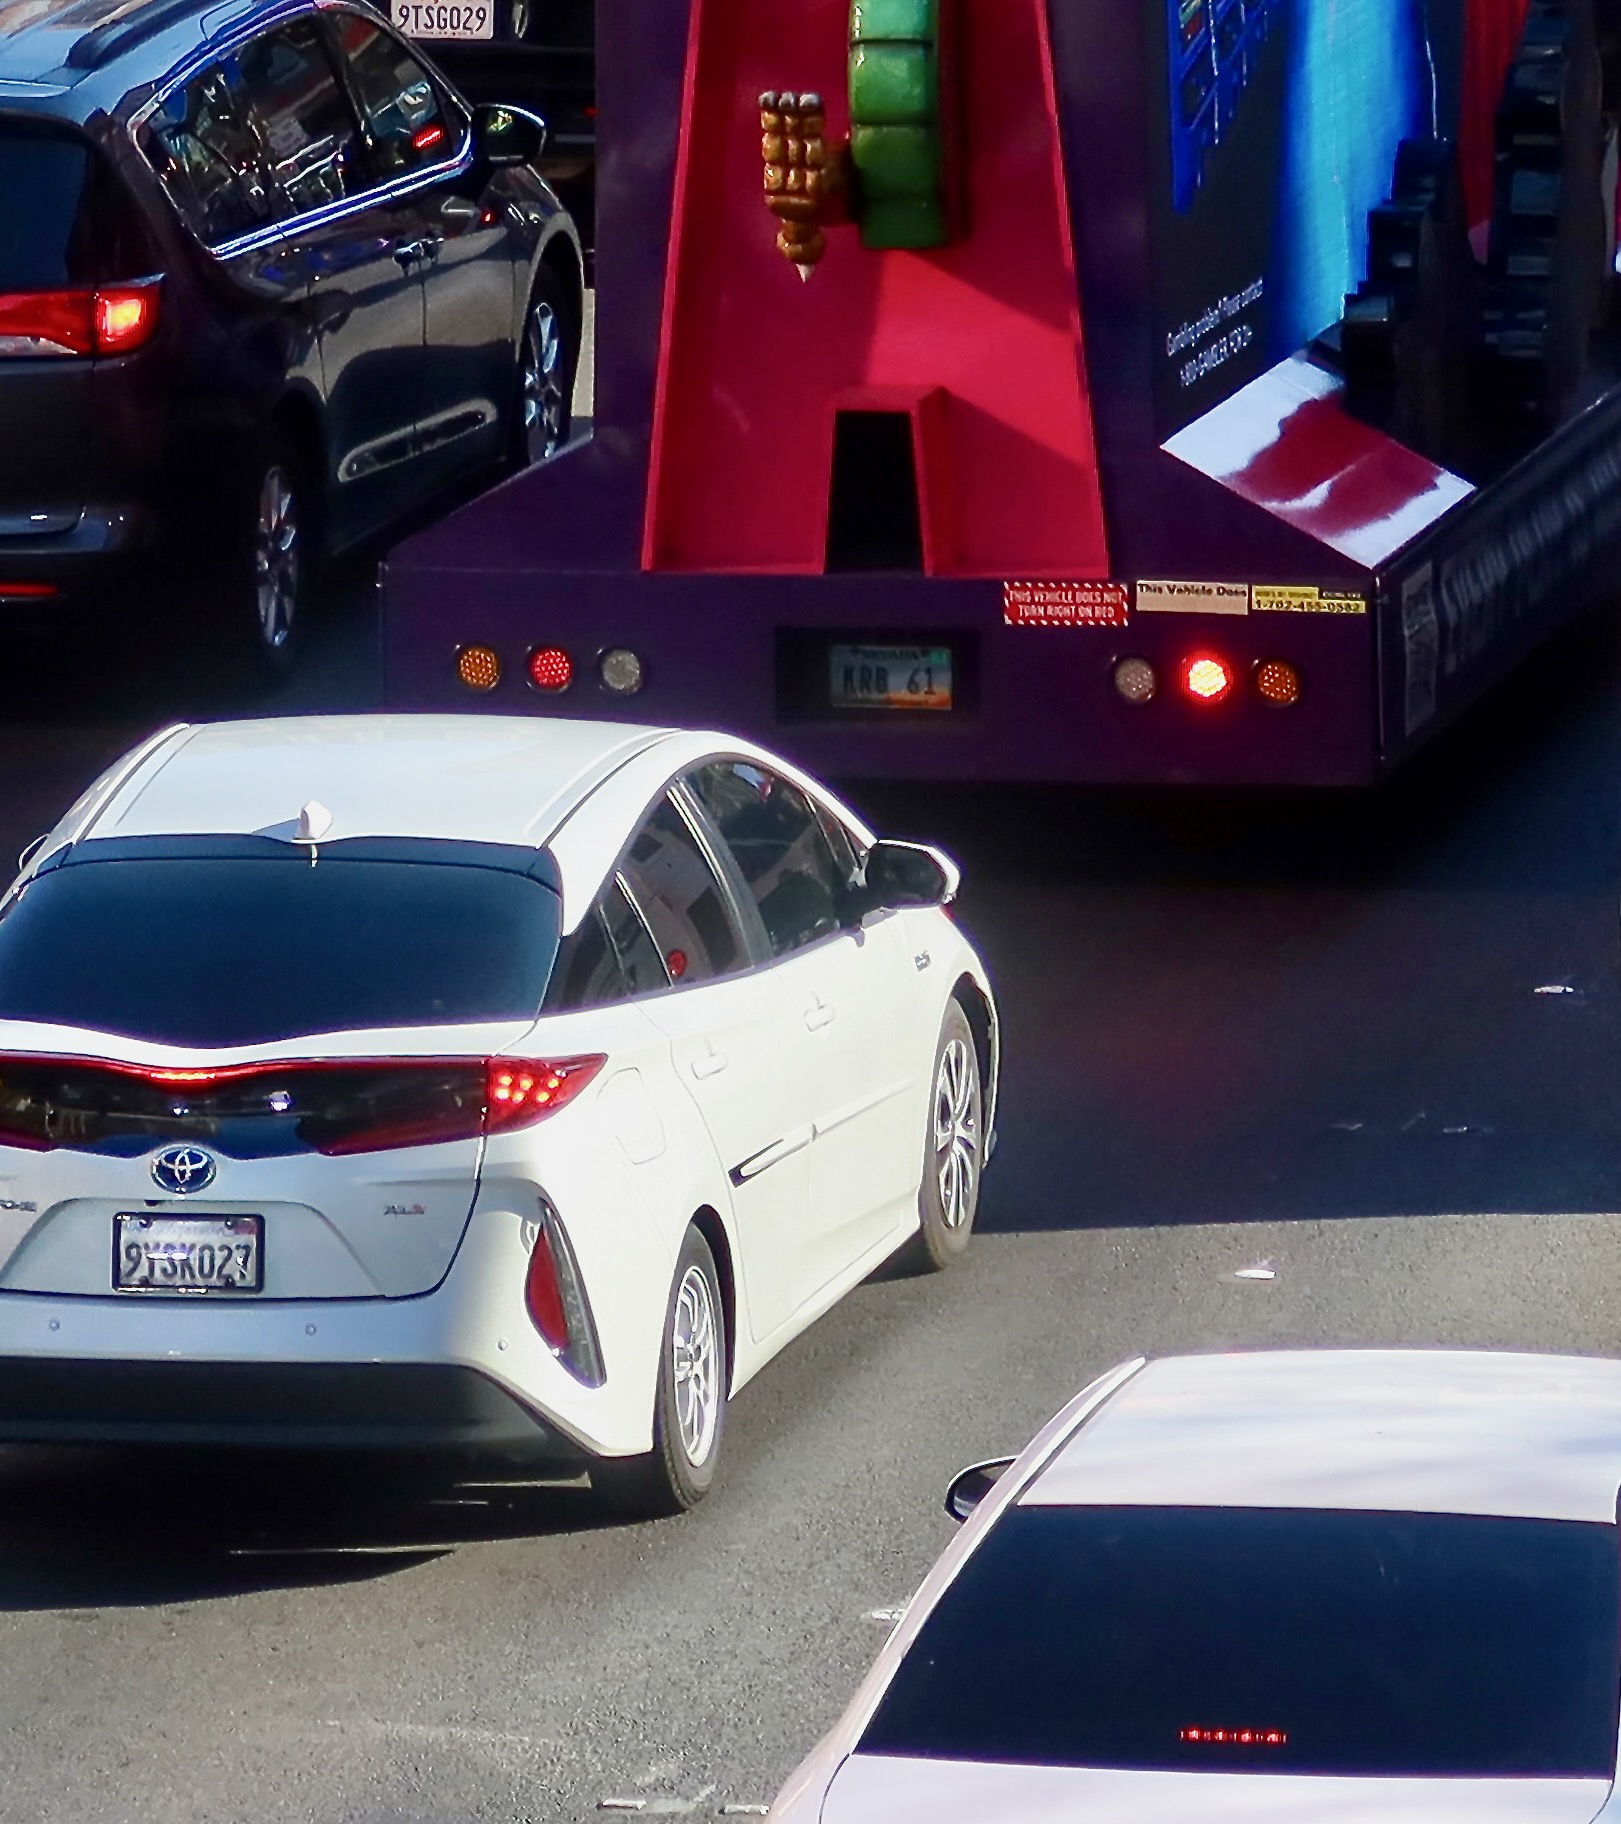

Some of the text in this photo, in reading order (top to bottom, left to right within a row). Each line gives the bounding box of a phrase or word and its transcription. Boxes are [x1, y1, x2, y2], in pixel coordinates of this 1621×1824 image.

[398, 4, 487, 33] 9TSG029
[1166, 584, 1213, 596] Vehicle
[1033, 590, 1074, 605] VEHICLE
[1075, 591, 1102, 604] DOES
[1018, 604, 1045, 617] TURN
[1046, 605, 1076, 618] RIGHT
[1094, 606, 1115, 618] RED
